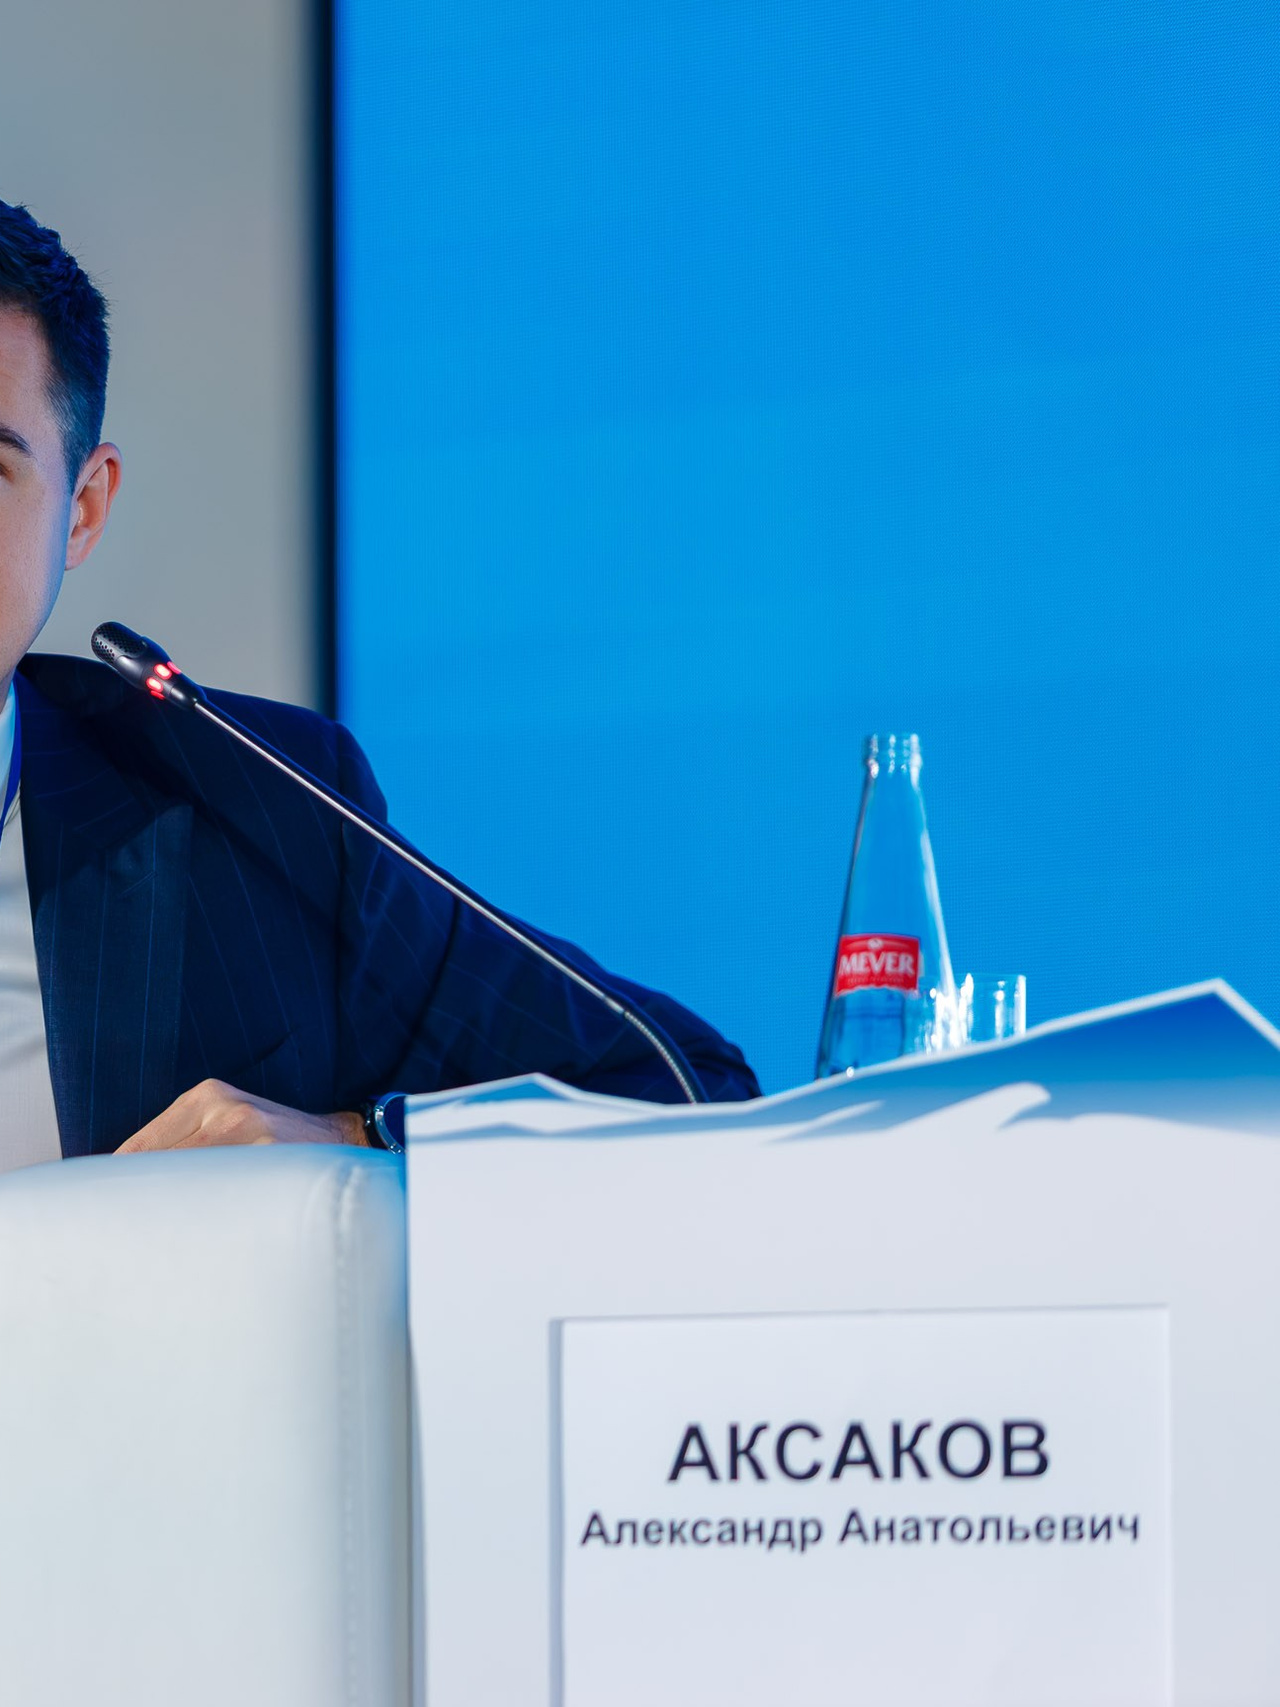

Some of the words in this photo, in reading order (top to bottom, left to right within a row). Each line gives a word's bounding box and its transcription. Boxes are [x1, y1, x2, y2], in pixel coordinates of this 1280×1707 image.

[839, 952, 914, 976] MEVER
[668, 1420, 1050, 1483] АКСАКОВ
[580, 1512, 823, 1553] Александр
[839, 1509, 1139, 1544] Анатольевич
